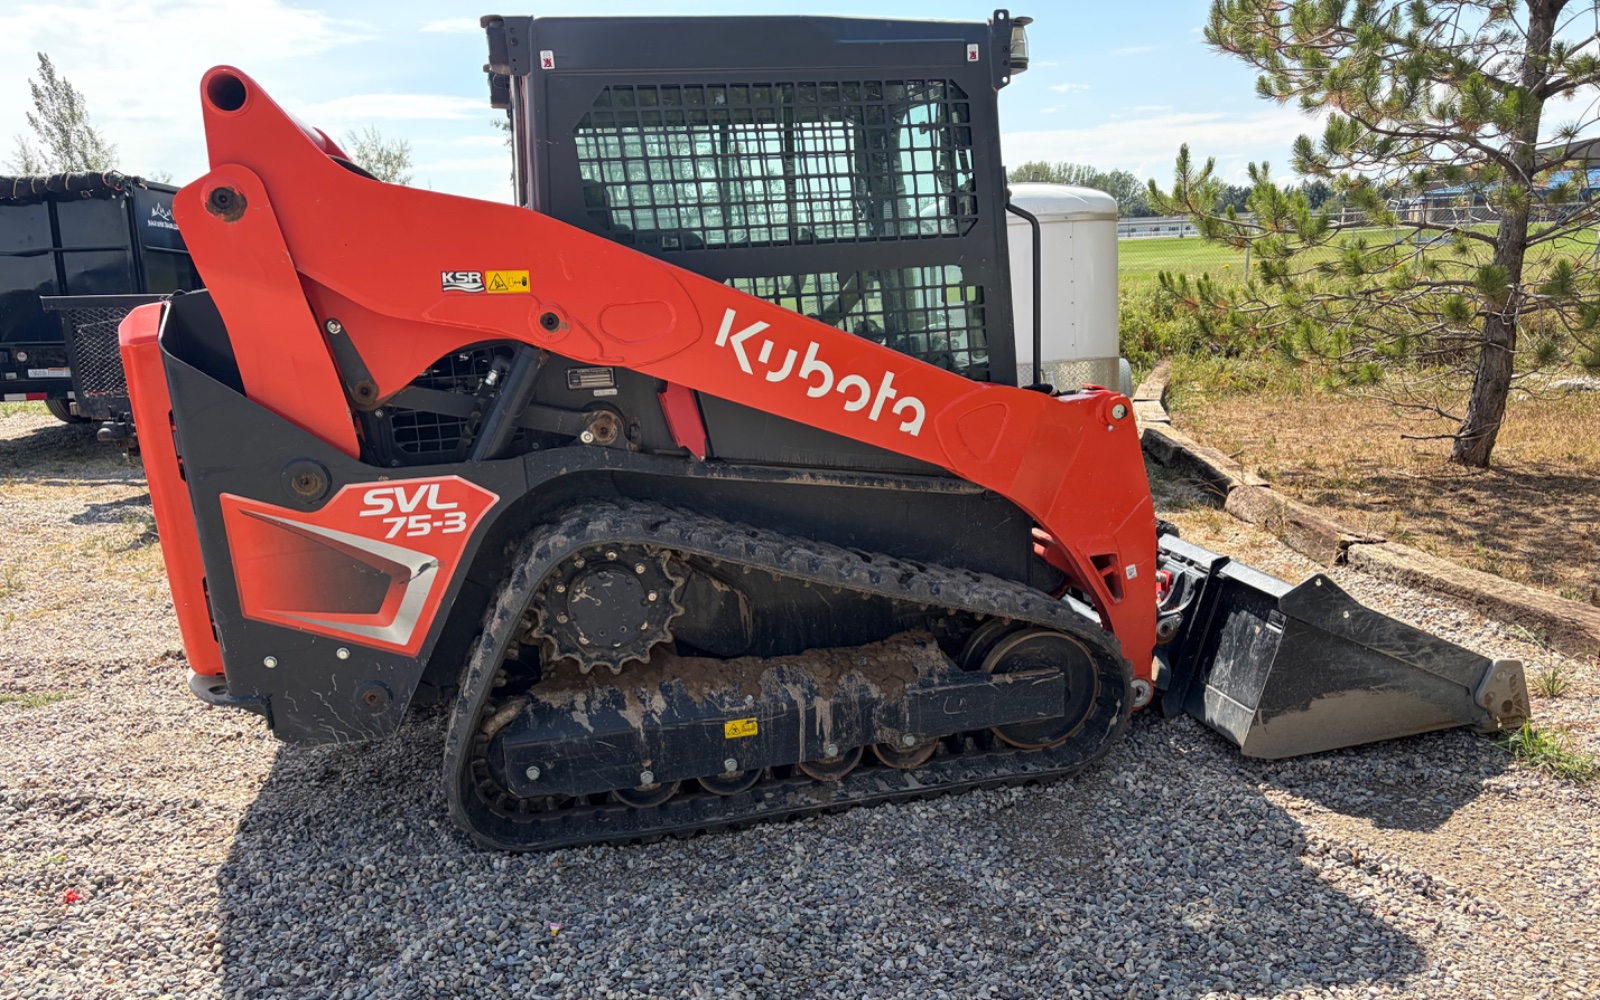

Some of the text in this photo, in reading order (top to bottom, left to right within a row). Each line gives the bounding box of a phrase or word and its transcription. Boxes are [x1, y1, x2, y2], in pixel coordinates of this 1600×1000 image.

[441, 271, 482, 283] KSR
[715, 308, 926, 437] Kubota
[359, 484, 458, 517] SVL
[382, 511, 467, 539] 75-3
